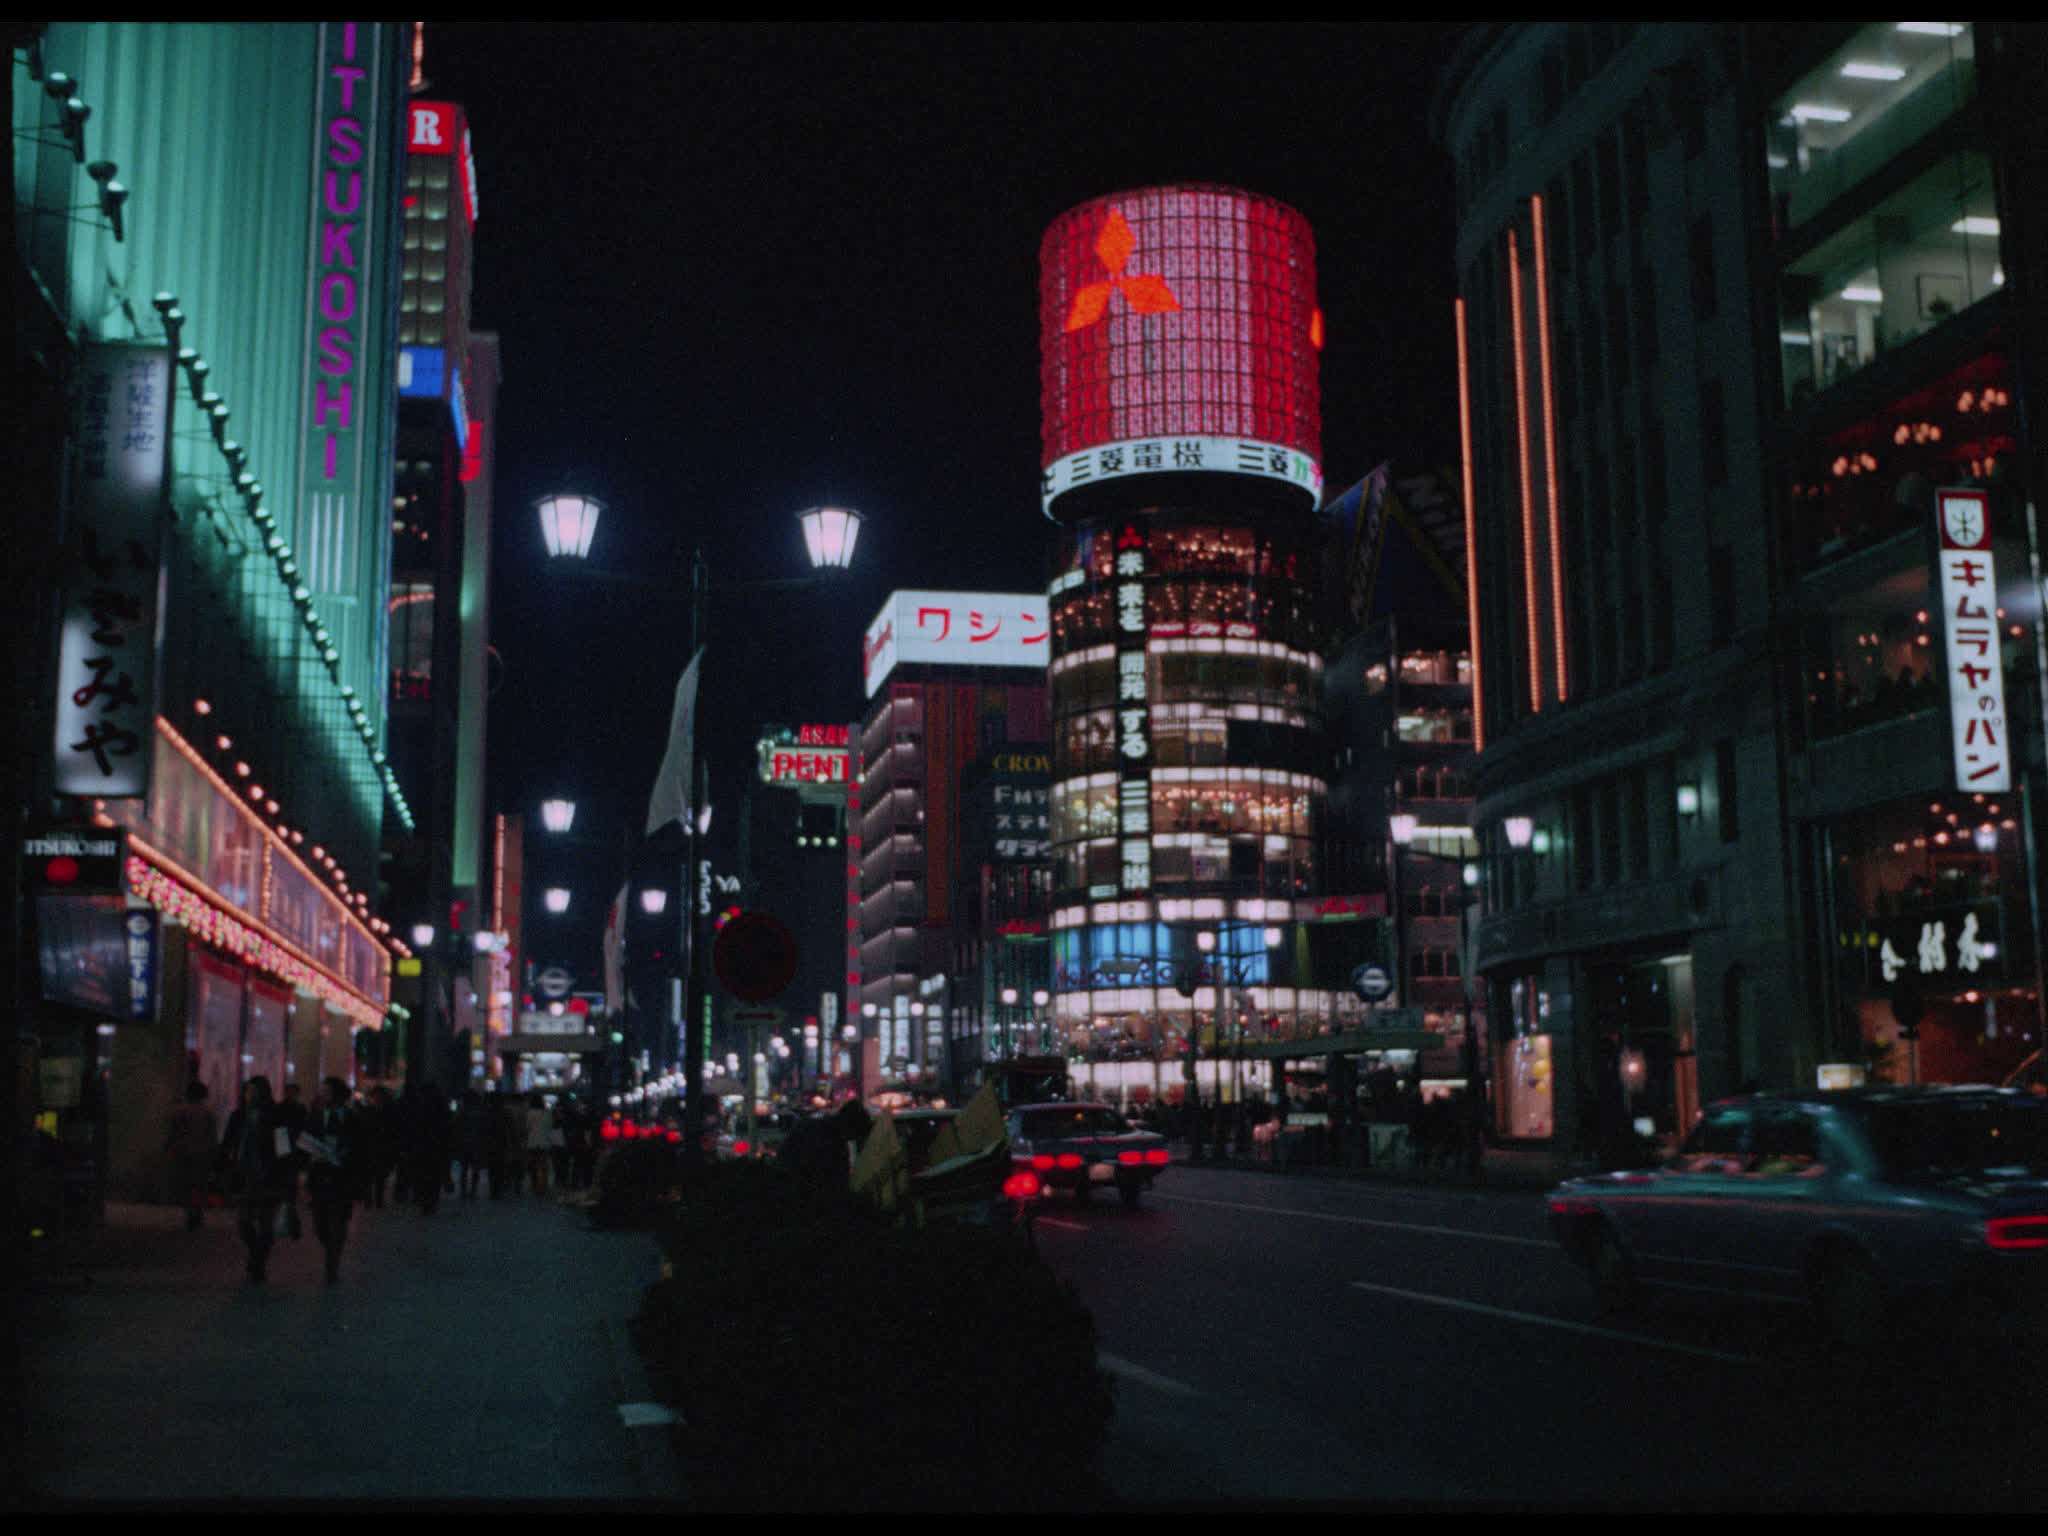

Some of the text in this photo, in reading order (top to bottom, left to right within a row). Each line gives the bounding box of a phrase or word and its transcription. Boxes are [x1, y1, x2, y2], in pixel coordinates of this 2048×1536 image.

[1071, 441, 1204, 482] 三菱電機
[918, 607, 1049, 644] ワシン
[1951, 559, 2001, 781] キムラヤのパン
